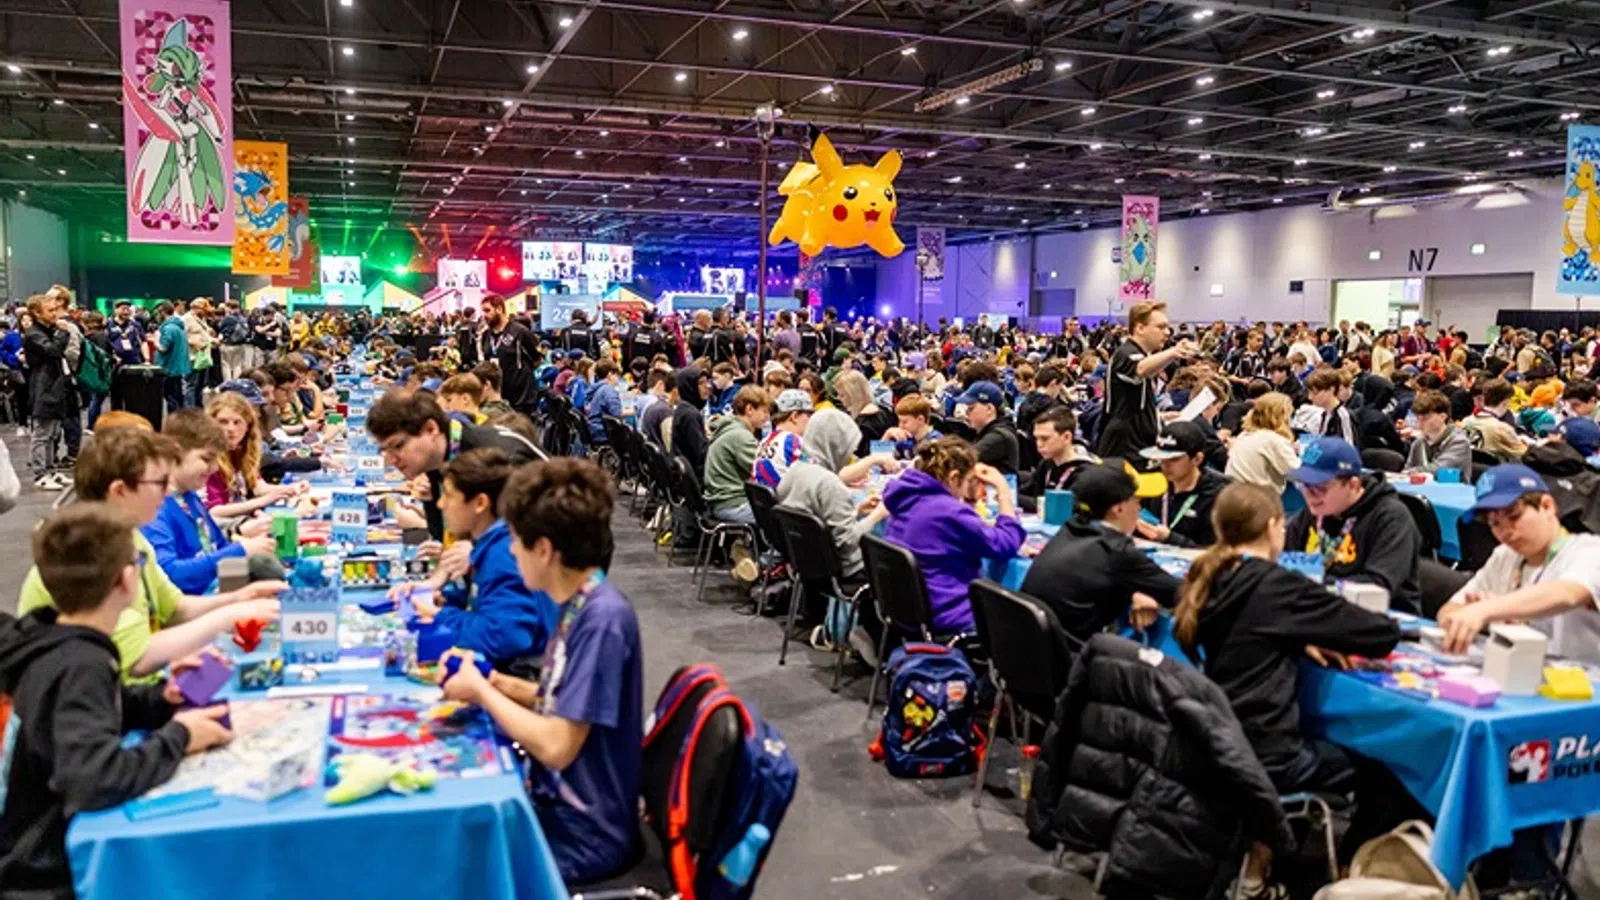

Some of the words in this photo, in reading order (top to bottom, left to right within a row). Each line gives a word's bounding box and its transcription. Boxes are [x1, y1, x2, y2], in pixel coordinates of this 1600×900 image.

[1408, 248, 1439, 272] N7
[338, 512, 361, 525] 428
[291, 619, 328, 635] 430
